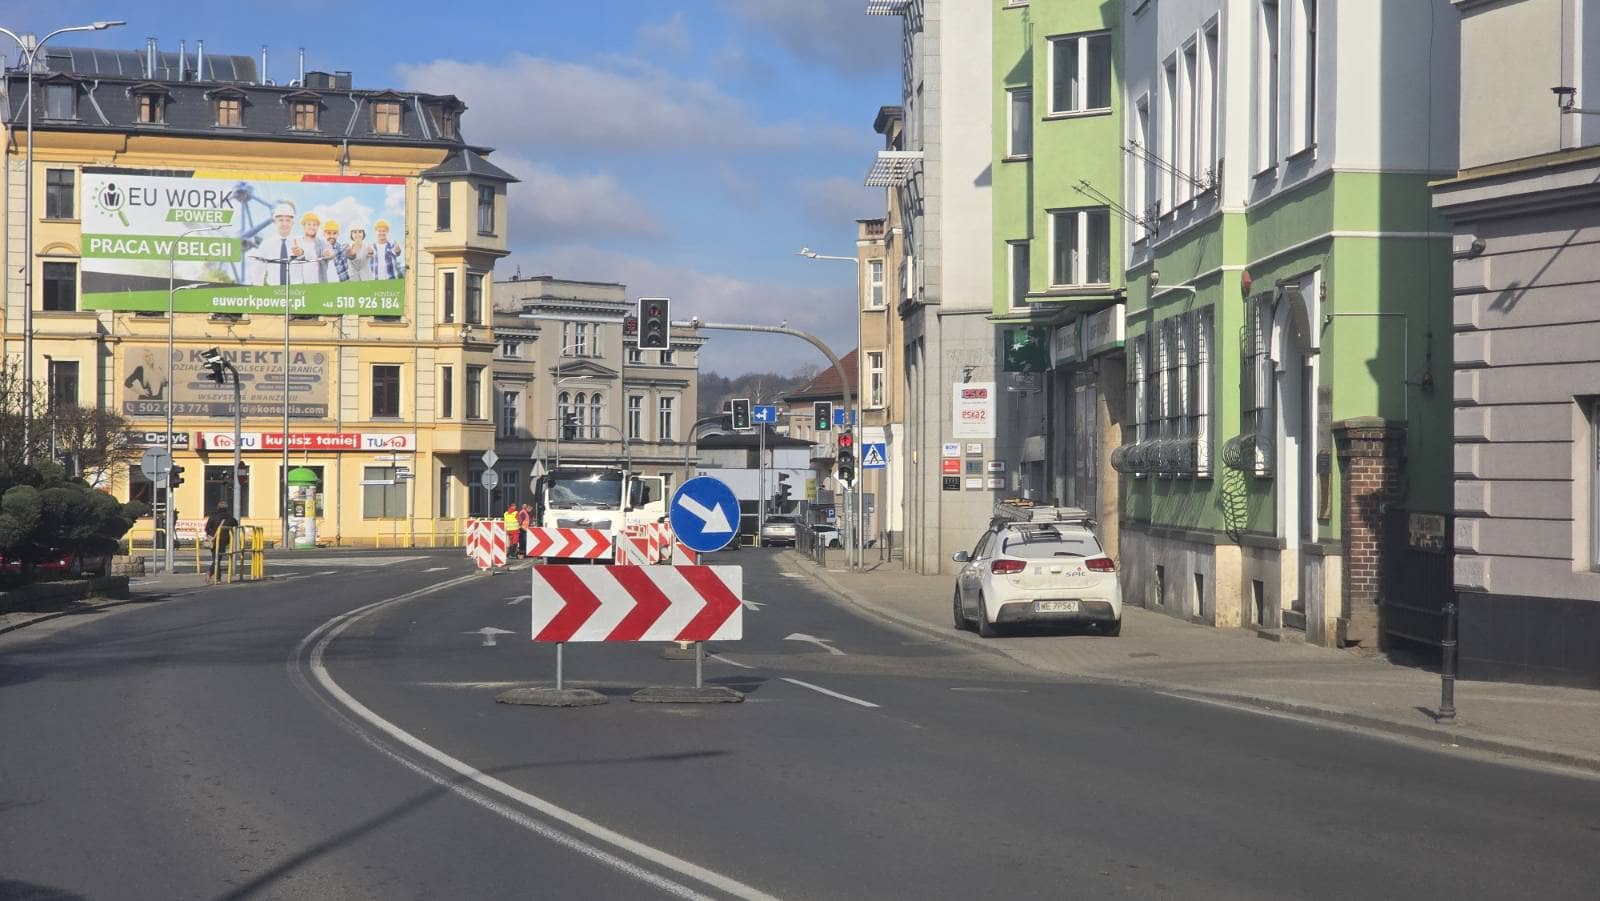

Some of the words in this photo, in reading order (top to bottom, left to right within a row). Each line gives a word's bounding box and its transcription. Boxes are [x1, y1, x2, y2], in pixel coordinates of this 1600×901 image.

[129, 187, 157, 206] EU
[166, 188, 234, 209] WORK
[175, 209, 223, 222] POWER
[90, 238, 150, 254] PRACA
[154, 240, 173, 255] W
[178, 241, 231, 257] BELGII
[212, 294, 305, 309] euworkpower.pl
[336, 296, 355, 308] 510
[358, 296, 378, 309] 926
[381, 297, 400, 309] 184
[190, 350, 307, 364] KNEKTA
[139, 403, 161, 412] 502
[188, 403, 209, 413] 774
[145, 432, 188, 443] Opyk
[316, 435, 357, 448] taniej
[367, 438, 384, 447] TU
